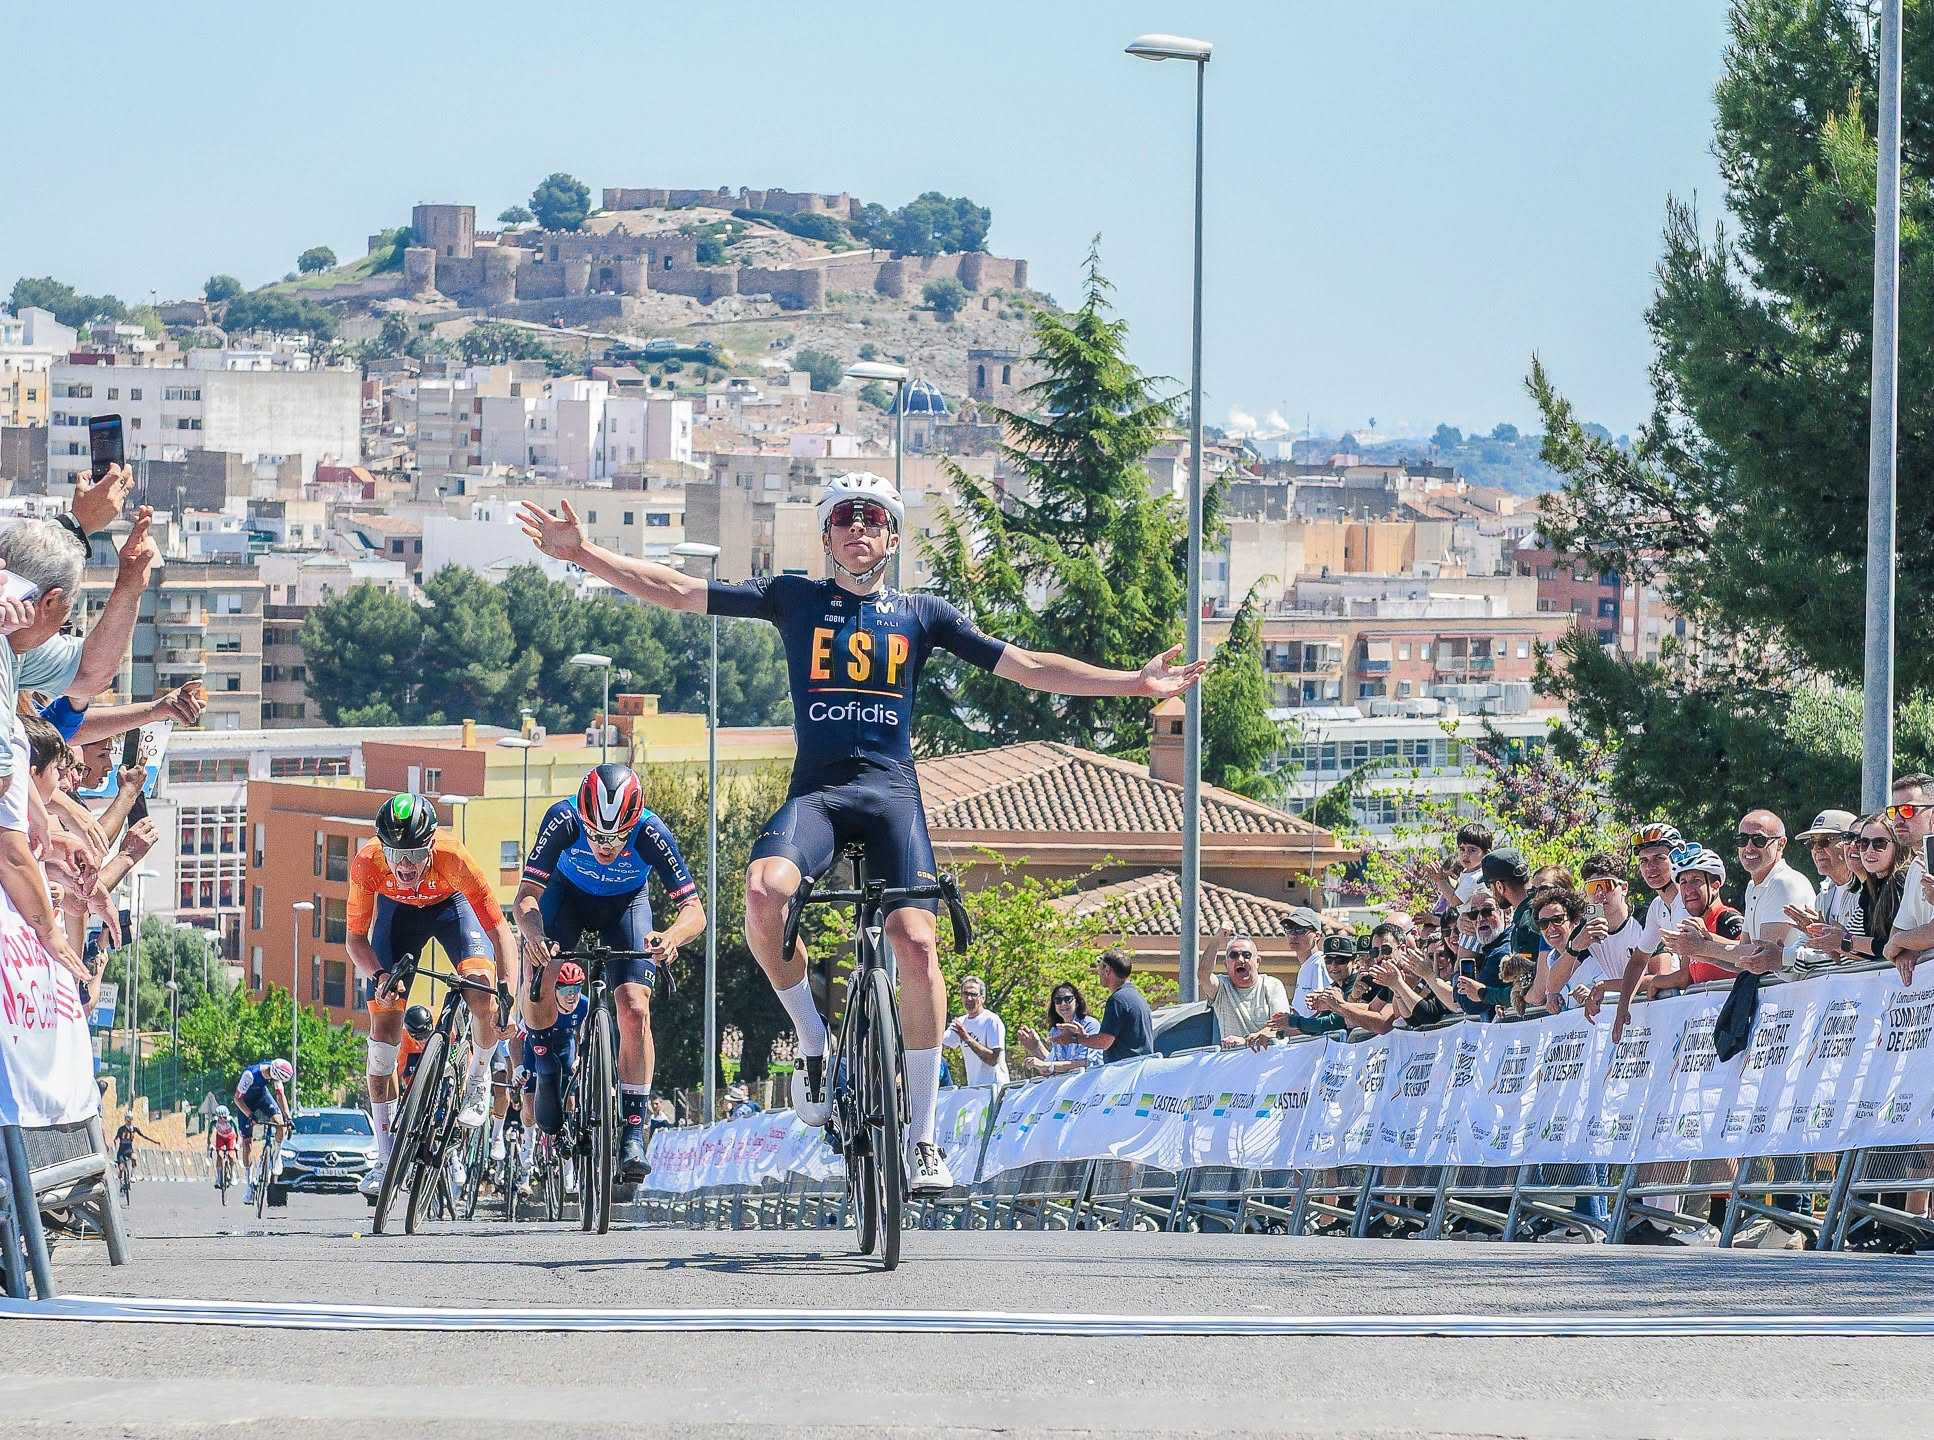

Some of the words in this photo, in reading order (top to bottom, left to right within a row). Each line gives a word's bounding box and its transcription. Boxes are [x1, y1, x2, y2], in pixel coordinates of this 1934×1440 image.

[810, 626, 910, 685] ESP
[808, 701, 899, 726] Cofidis
[529, 809, 573, 861] CASTELLI
[645, 825, 687, 882] CASTELLI
[1887, 1031, 1904, 1052] DE
[1153, 1094, 1187, 1115] CASTELL
